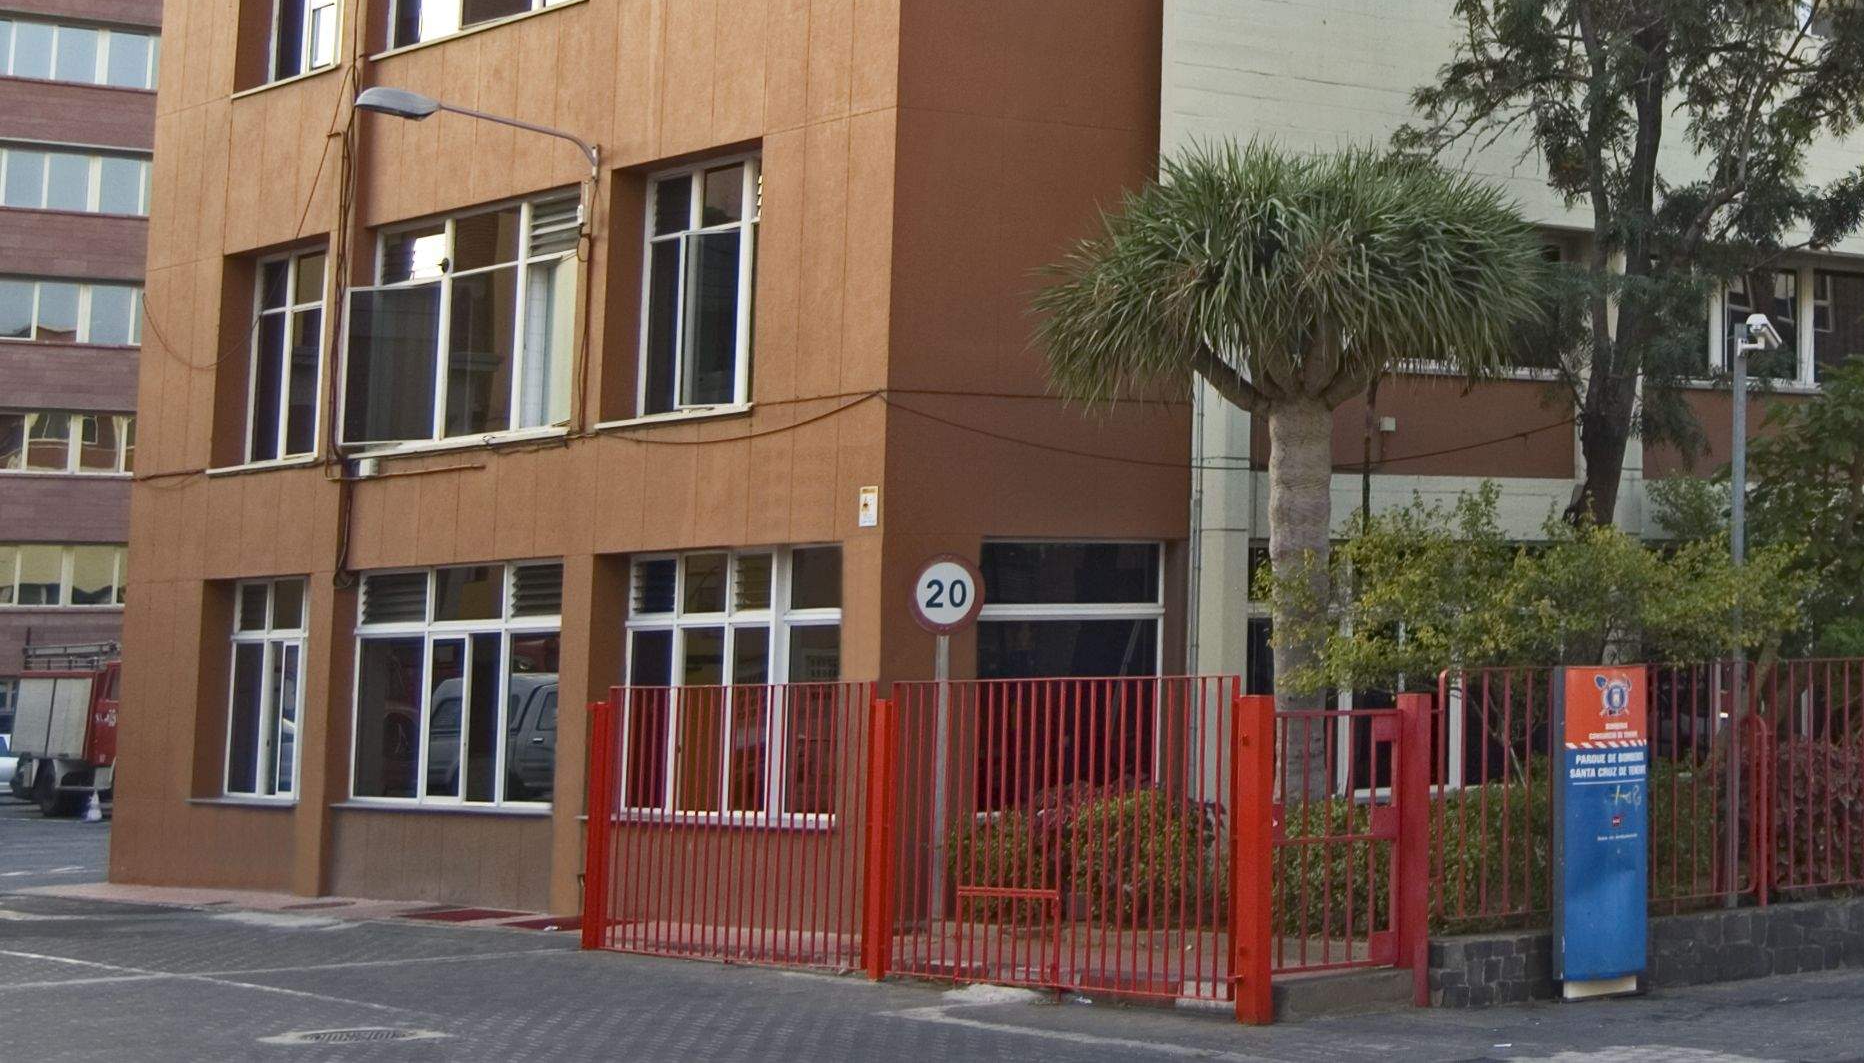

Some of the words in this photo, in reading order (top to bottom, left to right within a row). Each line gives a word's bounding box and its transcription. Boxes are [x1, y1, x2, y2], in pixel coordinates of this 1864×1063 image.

[925, 578, 967, 609] 20
[1569, 767, 1596, 779] SANTA
[1597, 766, 1618, 778] CRUZ
[1618, 766, 1627, 777] DE
